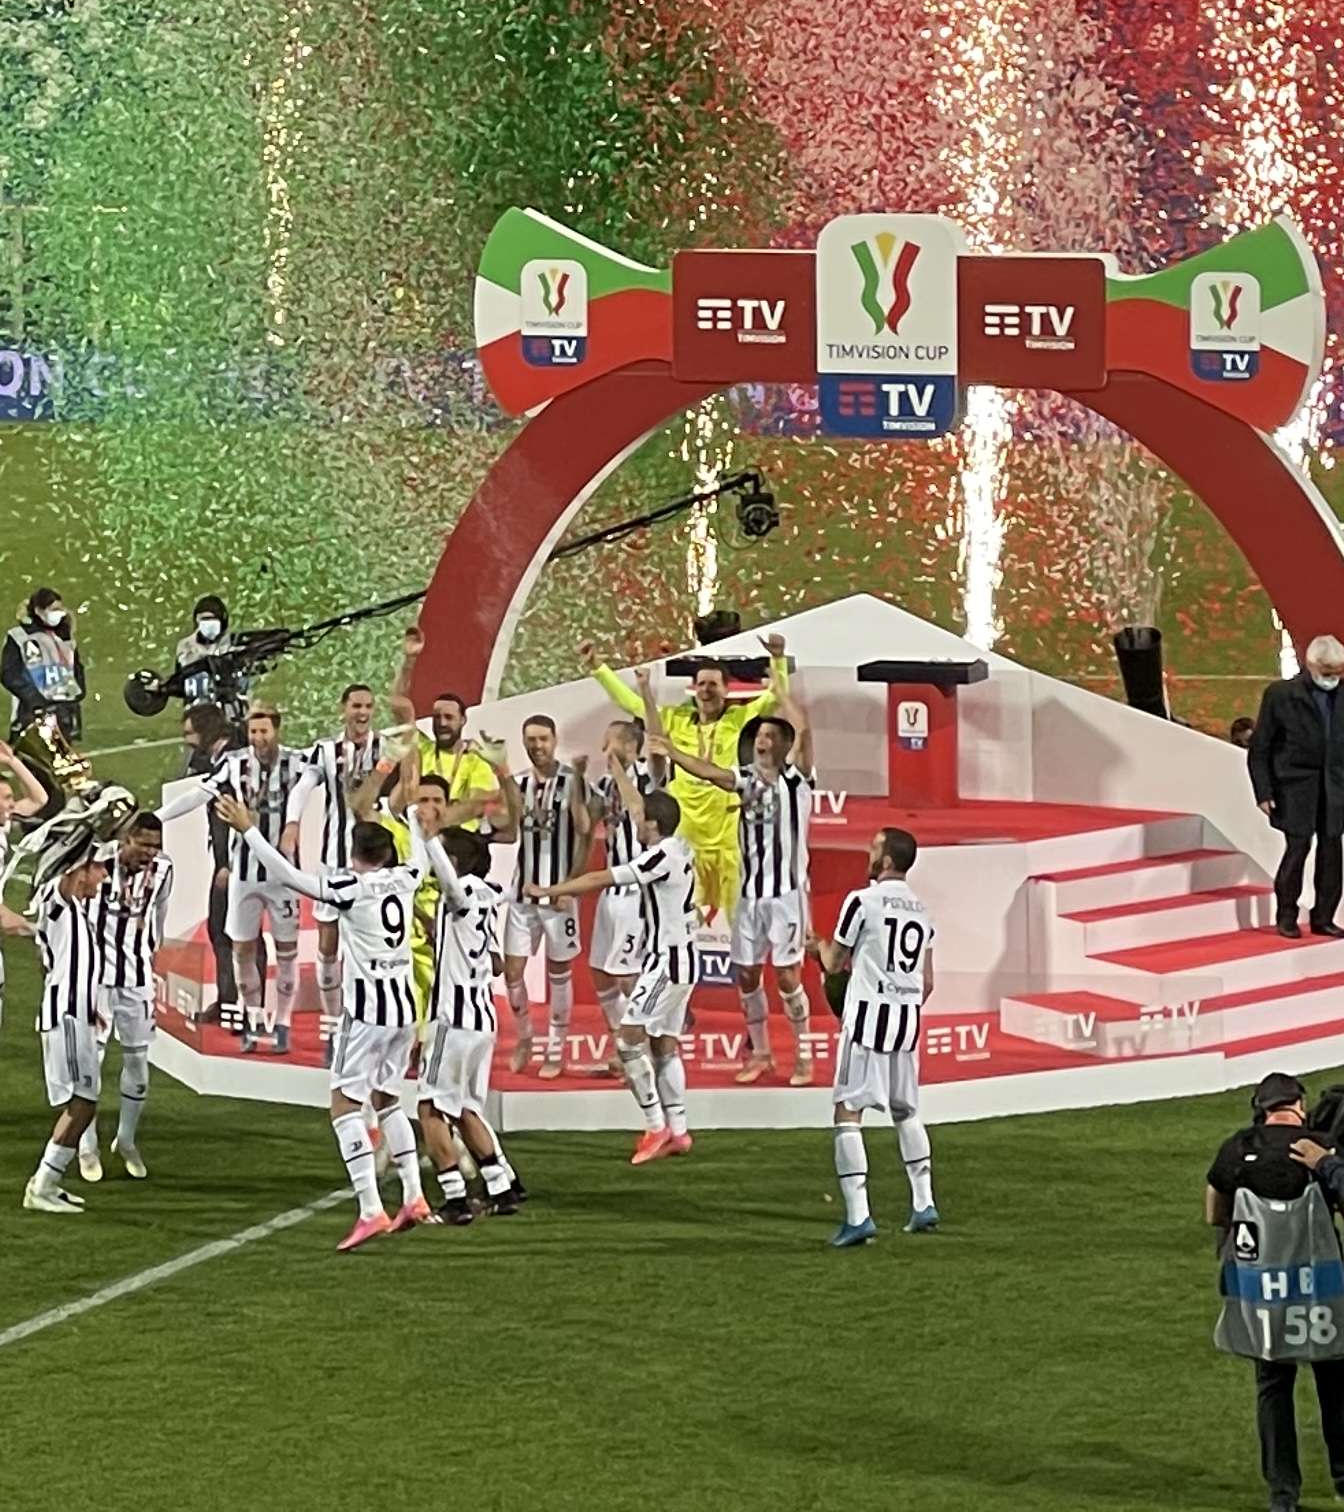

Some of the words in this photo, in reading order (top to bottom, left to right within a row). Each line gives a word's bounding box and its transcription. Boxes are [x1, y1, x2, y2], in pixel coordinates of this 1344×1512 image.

[737, 299, 786, 330] TV
[1024, 306, 1075, 336] TV
[551, 339, 577, 356] TV
[827, 344, 909, 360] TIMVISION
[914, 345, 949, 360] CUP
[1222, 353, 1249, 371] TV
[881, 384, 935, 417] TV
[812, 790, 847, 813] TV
[381, 894, 405, 949] 9
[565, 917, 576, 937] 8
[788, 923, 797, 941] 7
[623, 935, 636, 954] 3
[884, 917, 924, 974] 19
[703, 955, 731, 976] TV
[631, 986, 646, 1006] 2
[954, 1022, 990, 1050] TV
[1064, 1011, 1097, 1038] TV
[567, 1035, 609, 1060] TV
[700, 1034, 742, 1060] TV
